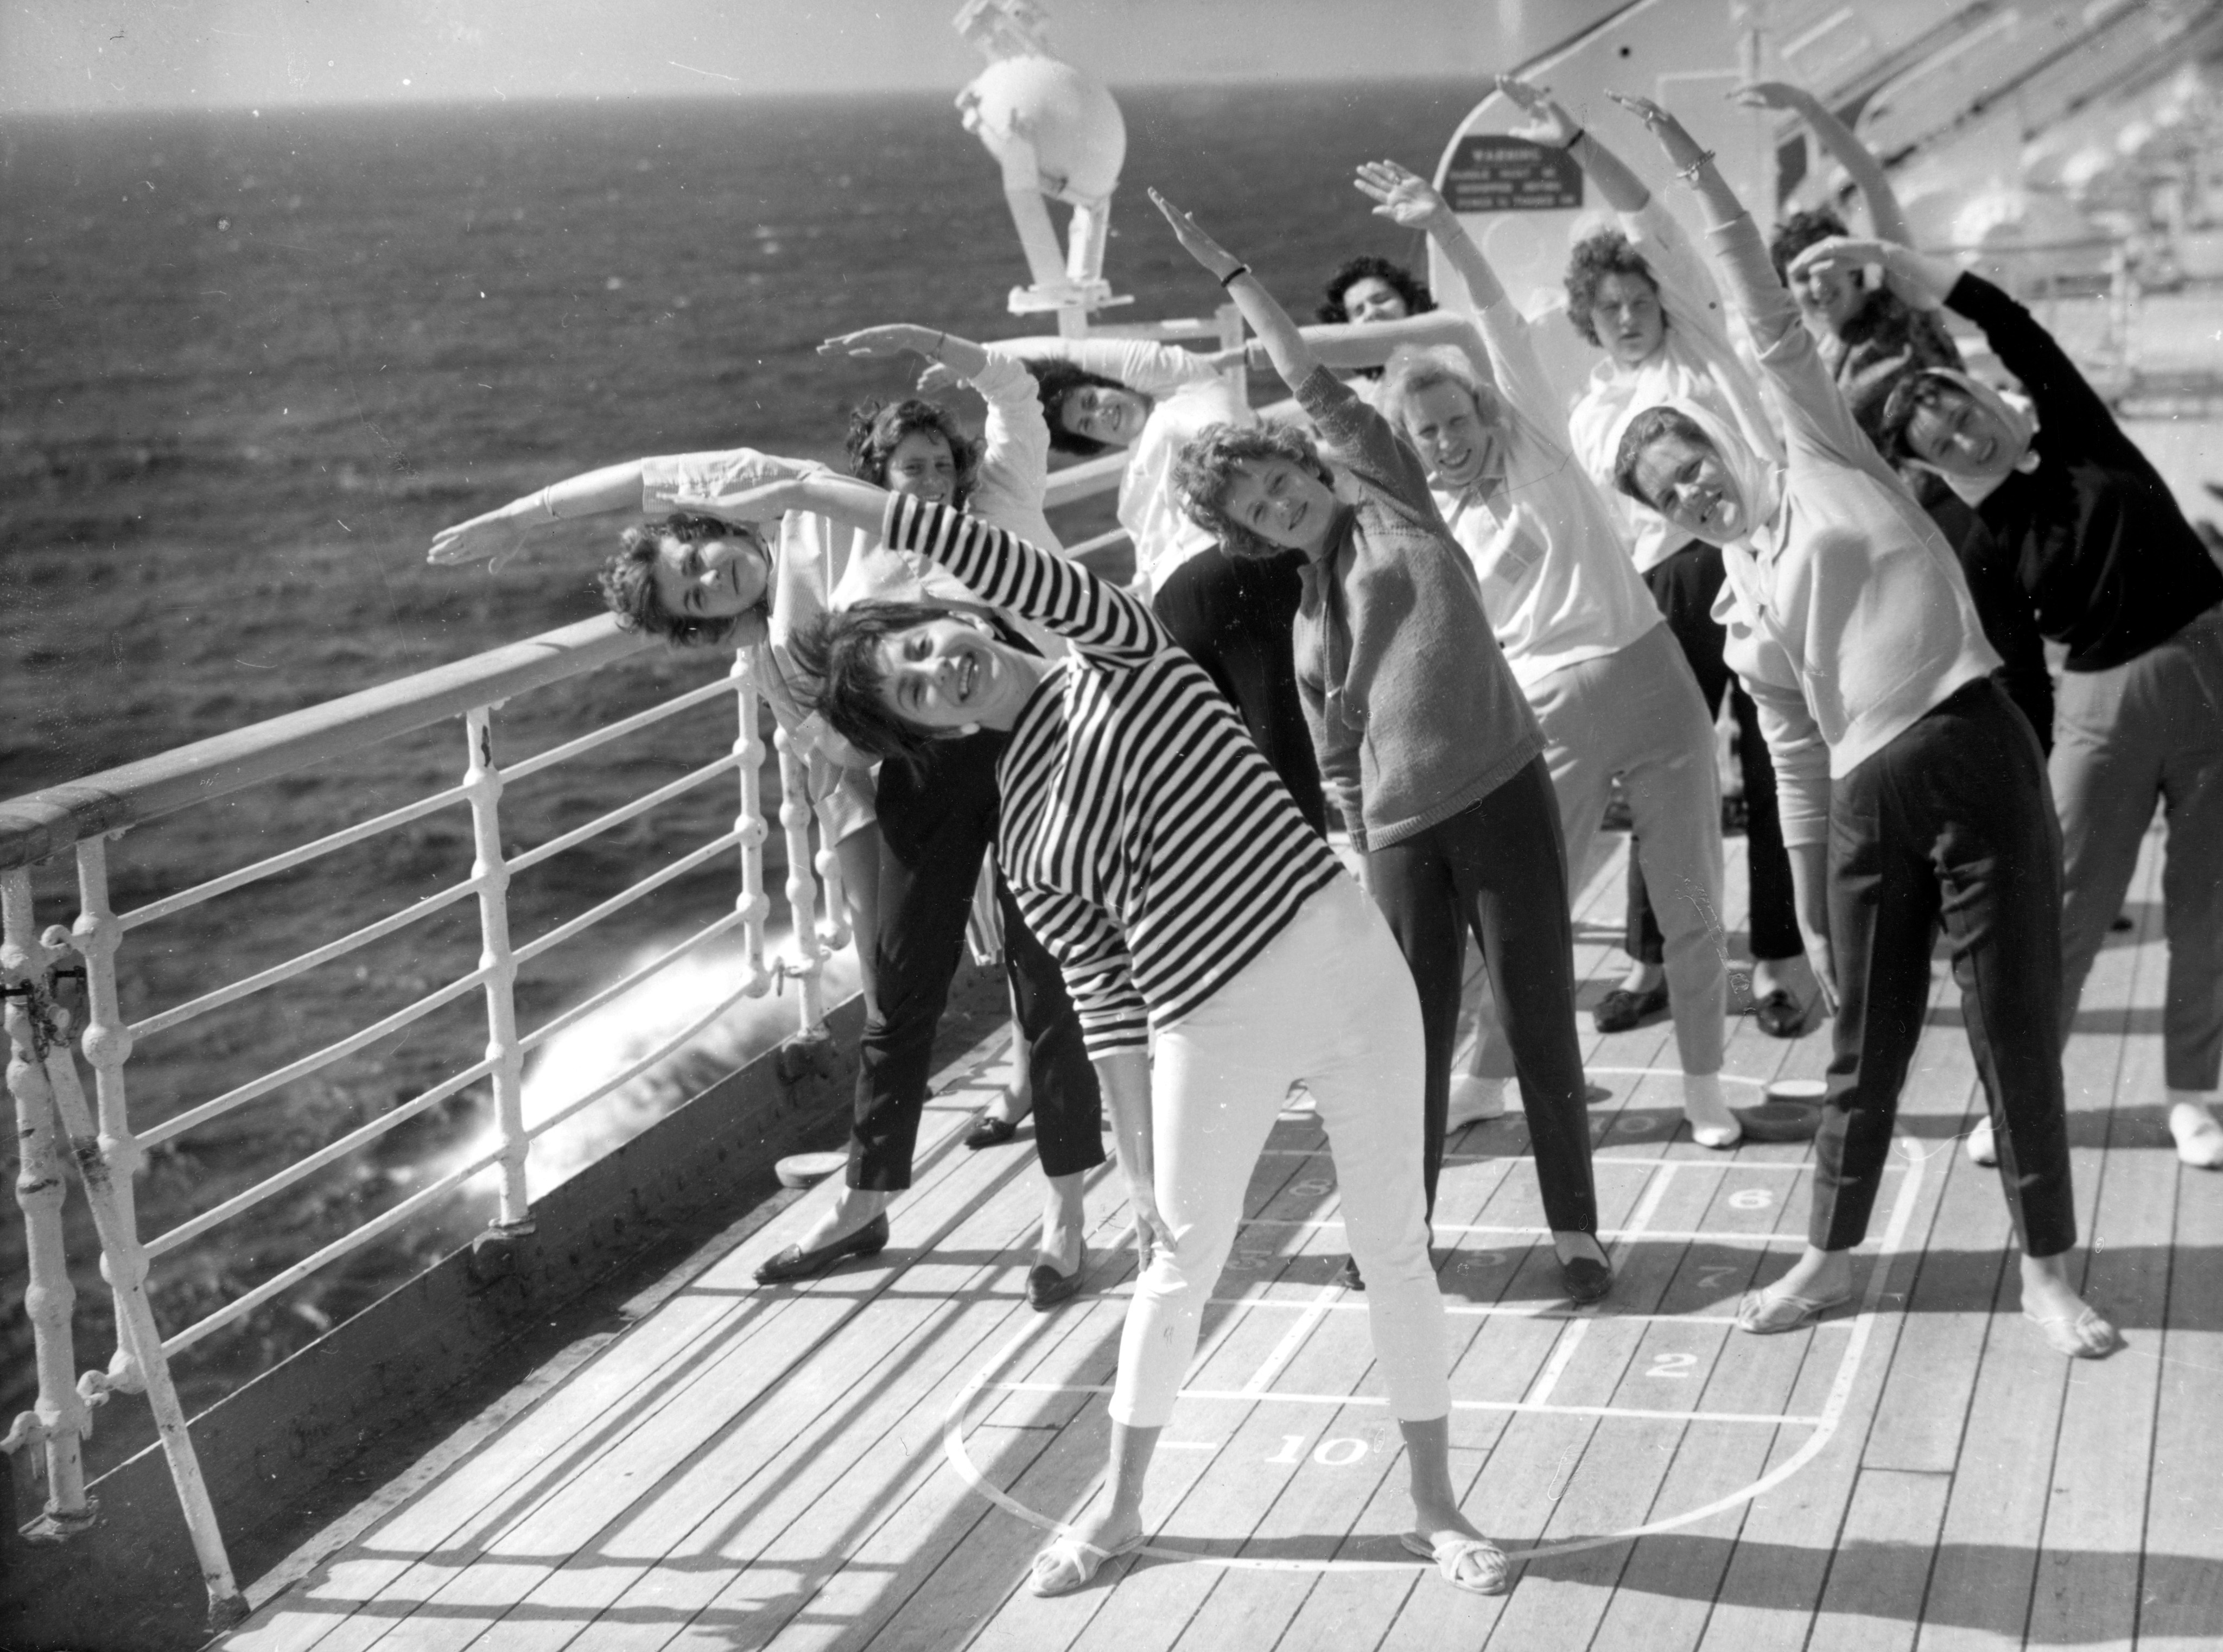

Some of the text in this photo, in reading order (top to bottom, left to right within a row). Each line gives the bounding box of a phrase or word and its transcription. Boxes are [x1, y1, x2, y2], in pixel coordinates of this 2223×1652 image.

[1288, 1178, 1331, 1196] 8
[1729, 1189, 1773, 1209] 6
[1697, 1266, 1737, 1288] 7
[1645, 1352, 1698, 1378] 2
